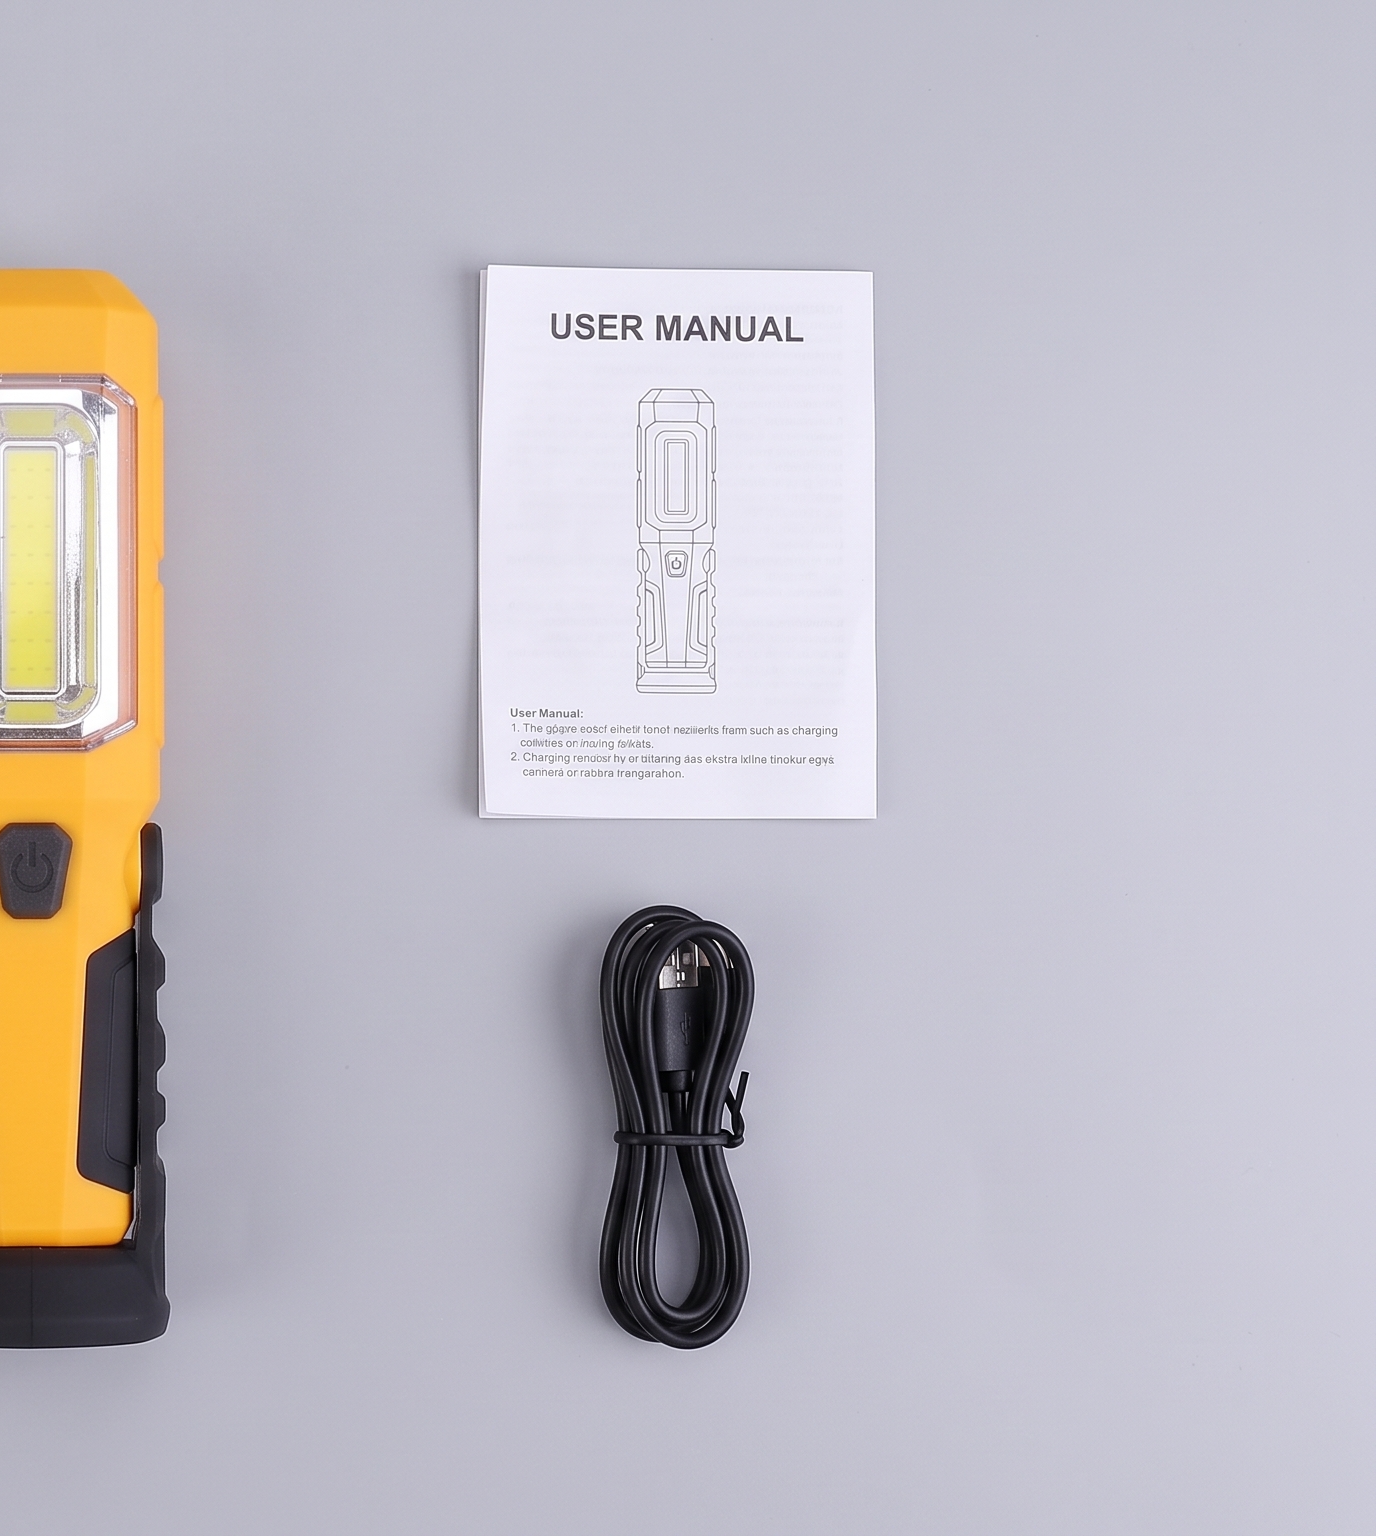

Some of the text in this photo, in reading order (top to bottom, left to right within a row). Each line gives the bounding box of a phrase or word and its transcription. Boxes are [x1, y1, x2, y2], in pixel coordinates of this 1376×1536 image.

[550, 313, 804, 342] USER MANUAL
[510, 708, 584, 719] User Manual:
[511, 723, 520, 733] 1.
[523, 723, 543, 733] The
[750, 725, 774, 735] such
[777, 727, 790, 735] as
[792, 725, 838, 738] charging
[510, 752, 520, 762] 2.
[523, 753, 571, 764] Charging
